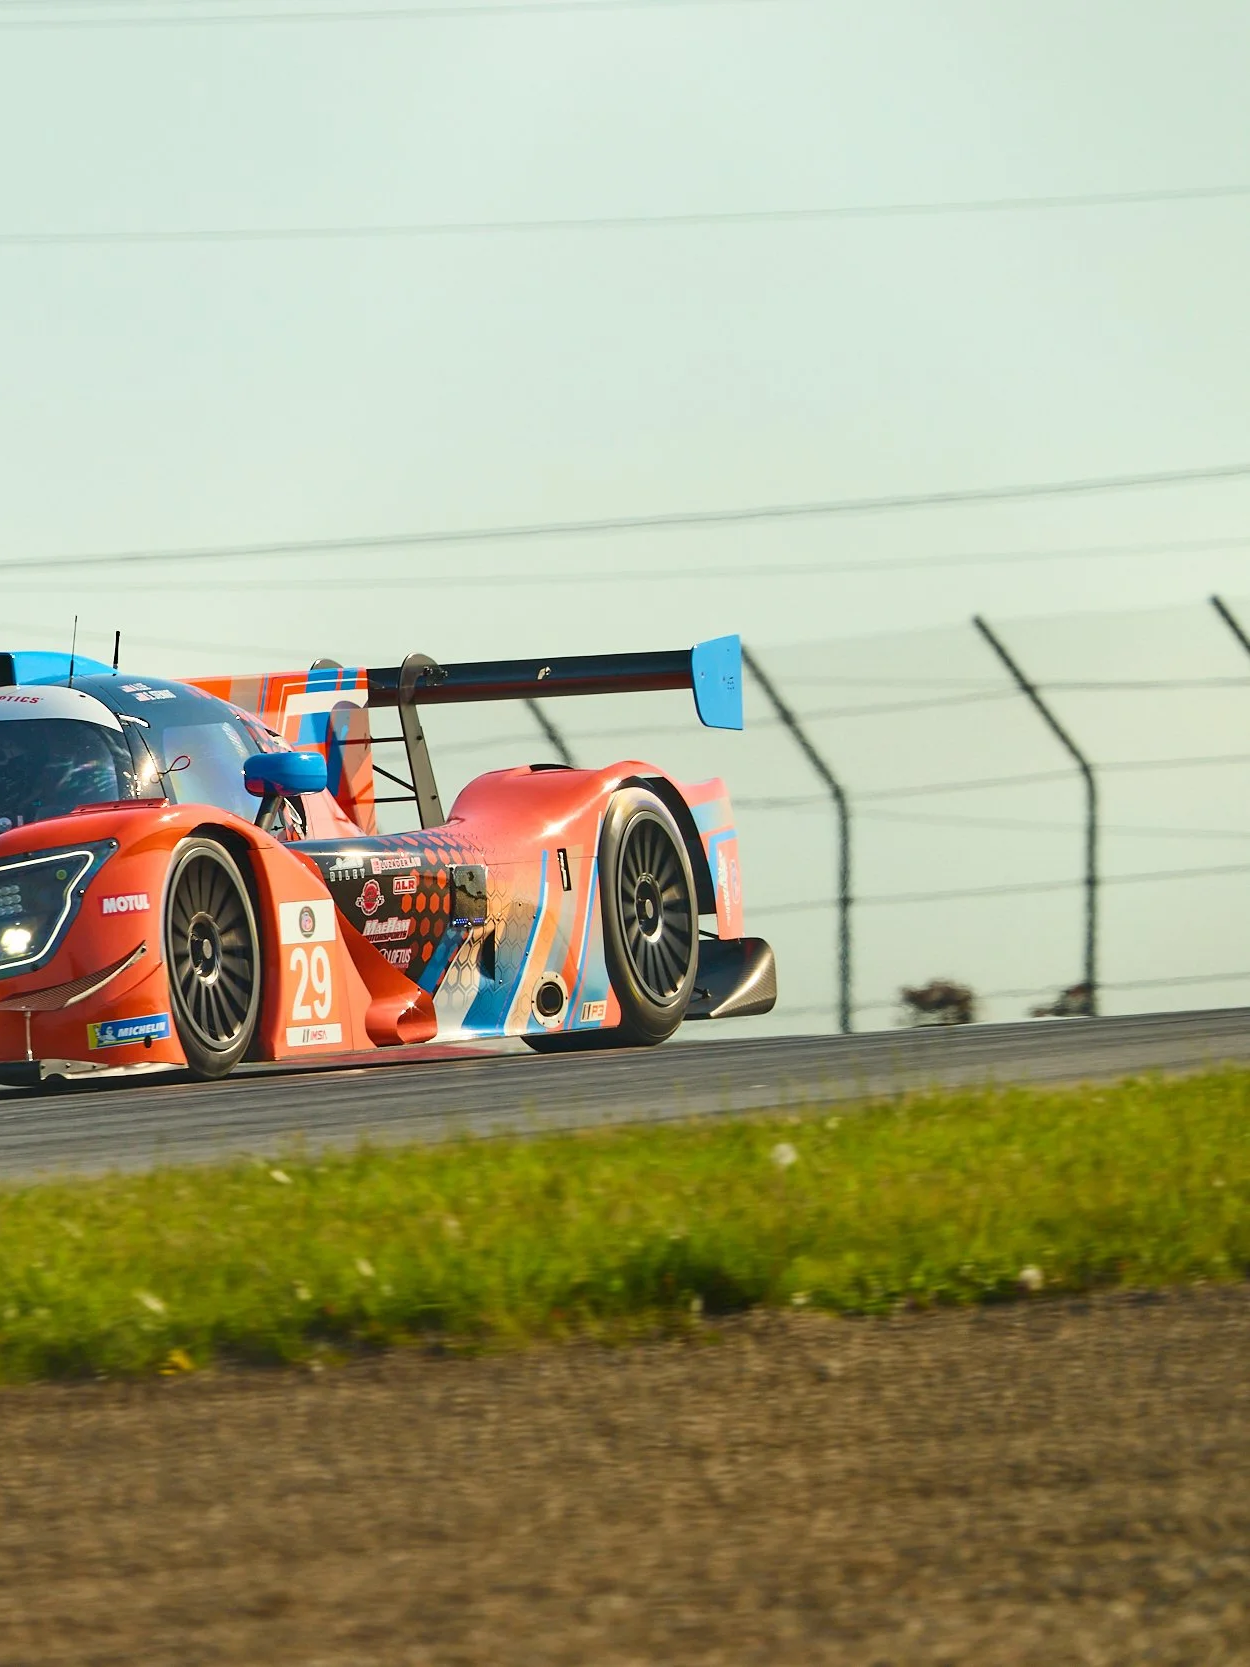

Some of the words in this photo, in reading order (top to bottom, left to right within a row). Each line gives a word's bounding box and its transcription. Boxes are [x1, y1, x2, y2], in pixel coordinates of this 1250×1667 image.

[330, 868, 366, 882] RILEY
[395, 881, 415, 890] ALR
[102, 893, 150, 914] MOTUL
[289, 945, 333, 1020] 29
[591, 1004, 605, 1017] P3
[117, 1021, 167, 1038] MICHELIN
